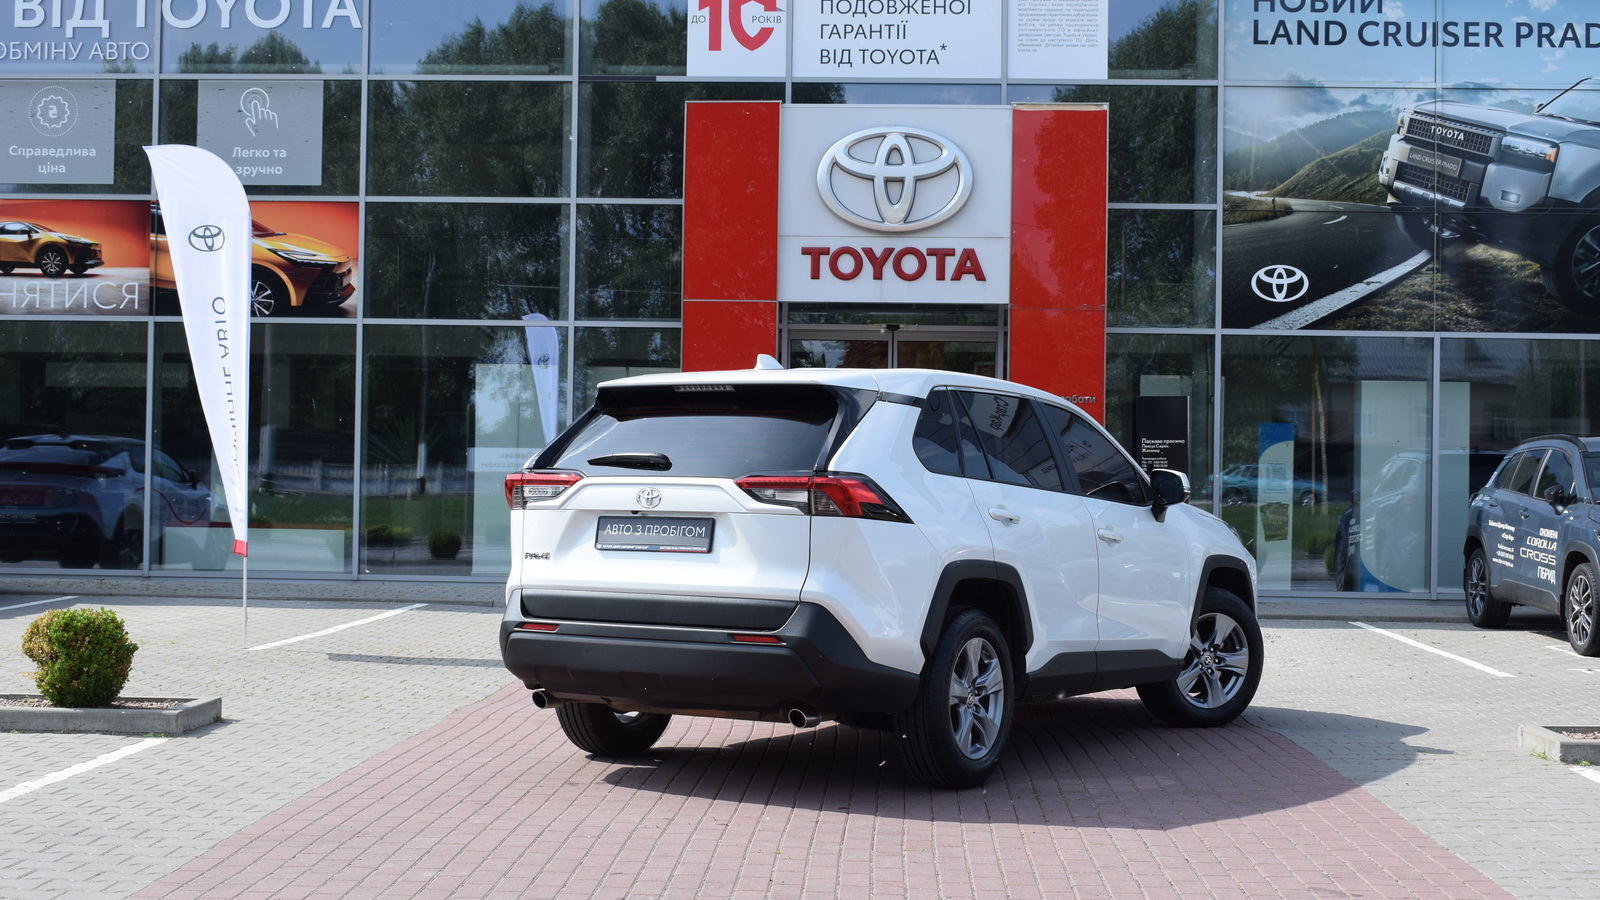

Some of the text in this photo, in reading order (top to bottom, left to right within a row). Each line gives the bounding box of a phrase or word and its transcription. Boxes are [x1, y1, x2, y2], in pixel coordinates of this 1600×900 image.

[14, 0, 110, 38] ВІД
[690, 15, 706, 24] ДО
[751, 15, 782, 24] РОКІВ
[820, 20, 908, 40] ГАРАНТІЇ
[1253, 20, 1600, 48] LAND CRUISER PRAD
[88, 41, 150, 60] АВТО
[820, 49, 852, 67] ВІД
[1430, 125, 1464, 141] TOYOTA
[9, 145, 97, 159] Справедлива
[231, 147, 287, 158] Легко та
[38, 162, 66, 174] ціна
[1410, 152, 1421, 161] LAND
[1442, 160, 1458, 171] PRADO
[236, 166, 283, 177] зручно
[801, 246, 987, 281] TOYOTA
[0, 281, 138, 309] НЯТИСЯ
[1061, 394, 1096, 403] оботи
[604, 524, 706, 537] АВТО З ПРОБІГОМ
[1526, 536, 1557, 551] COROLLA
[1520, 547, 1556, 565] CROSS
